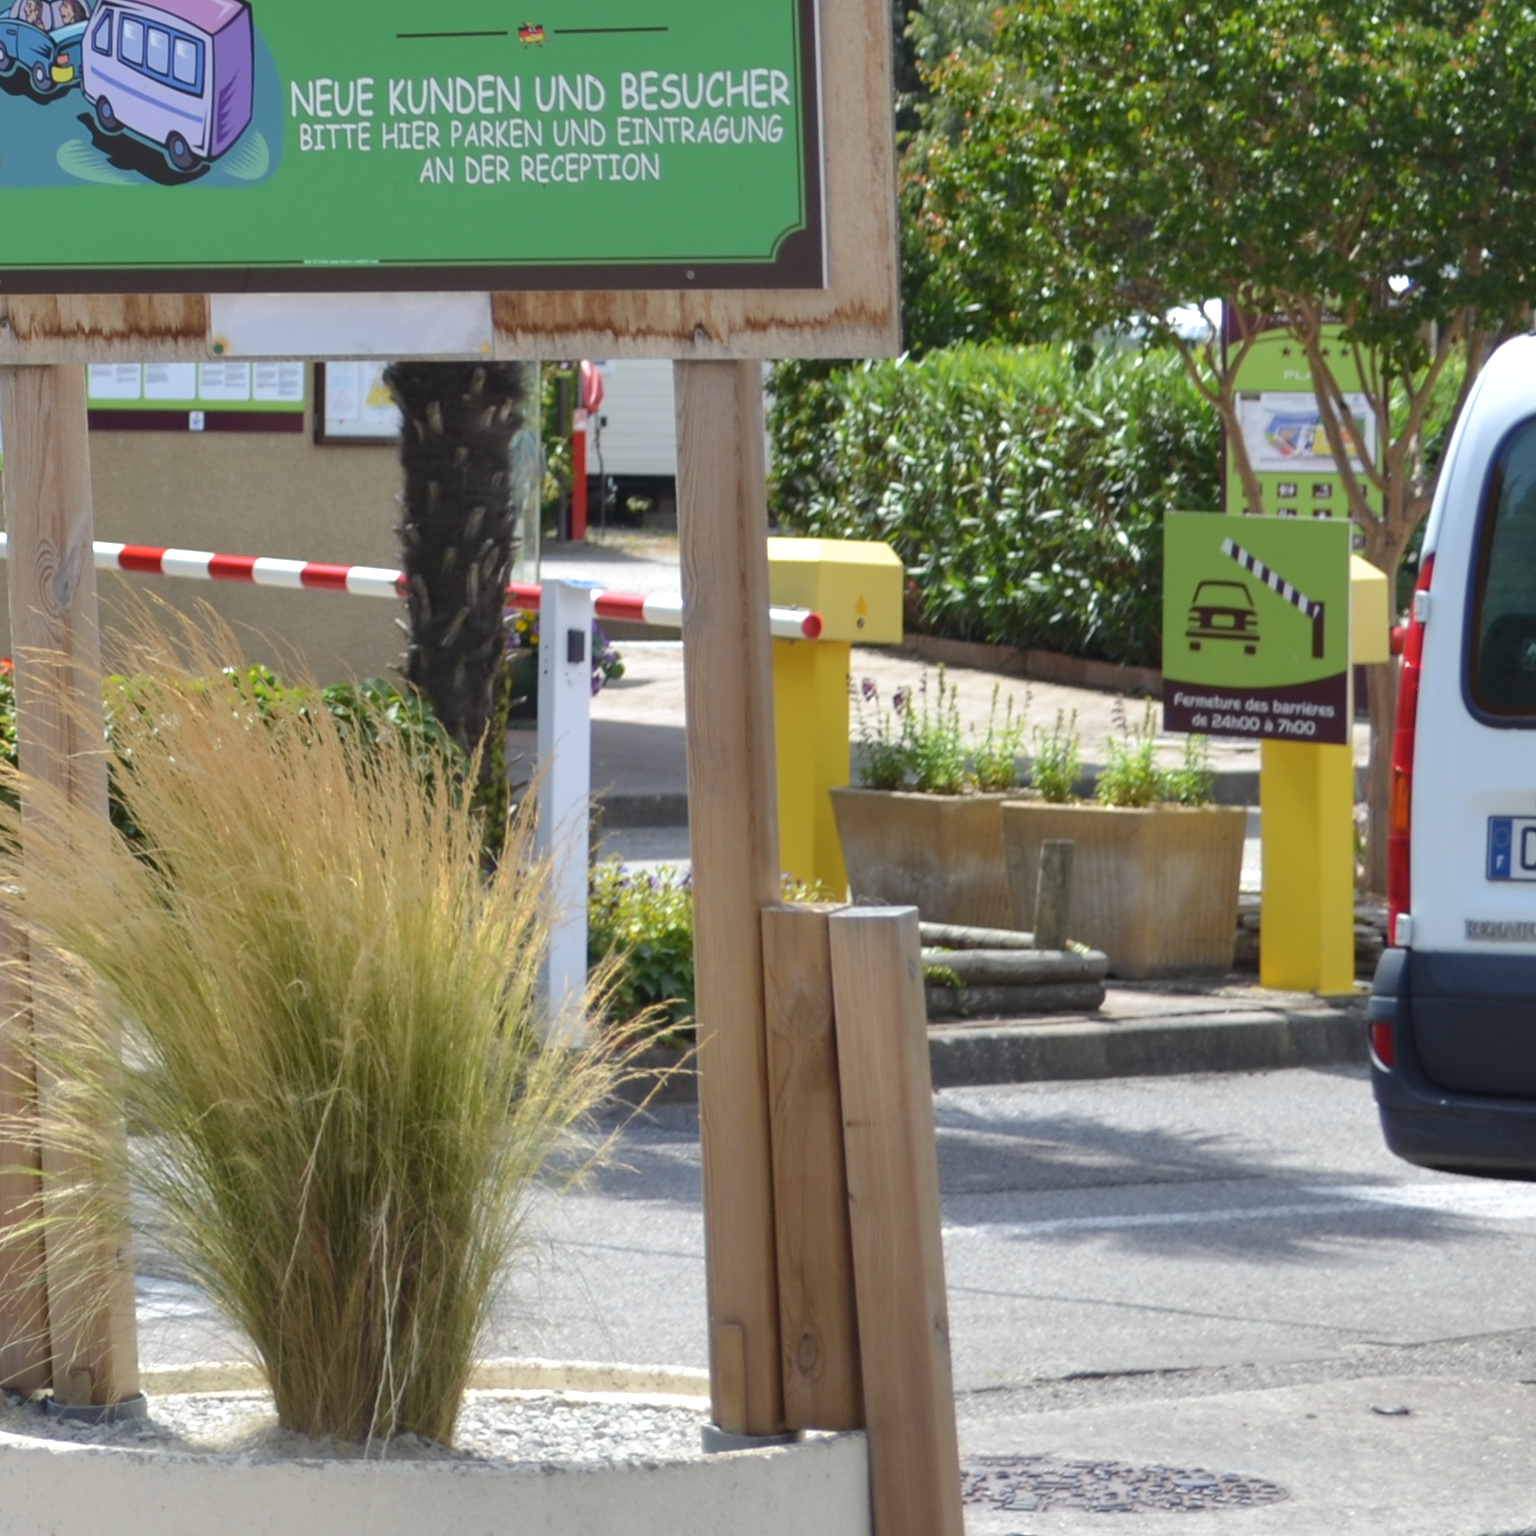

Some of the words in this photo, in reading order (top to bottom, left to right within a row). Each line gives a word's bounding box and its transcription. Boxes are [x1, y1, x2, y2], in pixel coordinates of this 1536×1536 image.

[290, 77, 375, 117] NEUE
[388, 74, 521, 116] KUNDEN
[535, 74, 606, 113] UND
[620, 68, 791, 111] BESUCHER
[299, 121, 371, 151] BITTE
[382, 119, 441, 150] HIER
[450, 118, 543, 149] PARKEN
[553, 117, 606, 147] UND
[616, 114, 784, 146] EINTRAGUNG
[419, 155, 454, 184] AN
[465, 154, 510, 184] DER
[521, 152, 660, 182] RECEPTION
[1174, 692, 1241, 711] Fermeture
[1245, 697, 1268, 713] des
[1273, 699, 1335, 718] barrières
[1192, 713, 1208, 727] de
[1212, 714, 1261, 731] 24h00
[1264, 717, 1274, 732] à
[1278, 718, 1316, 736] 7h00
[1496, 854, 1505, 870] F
